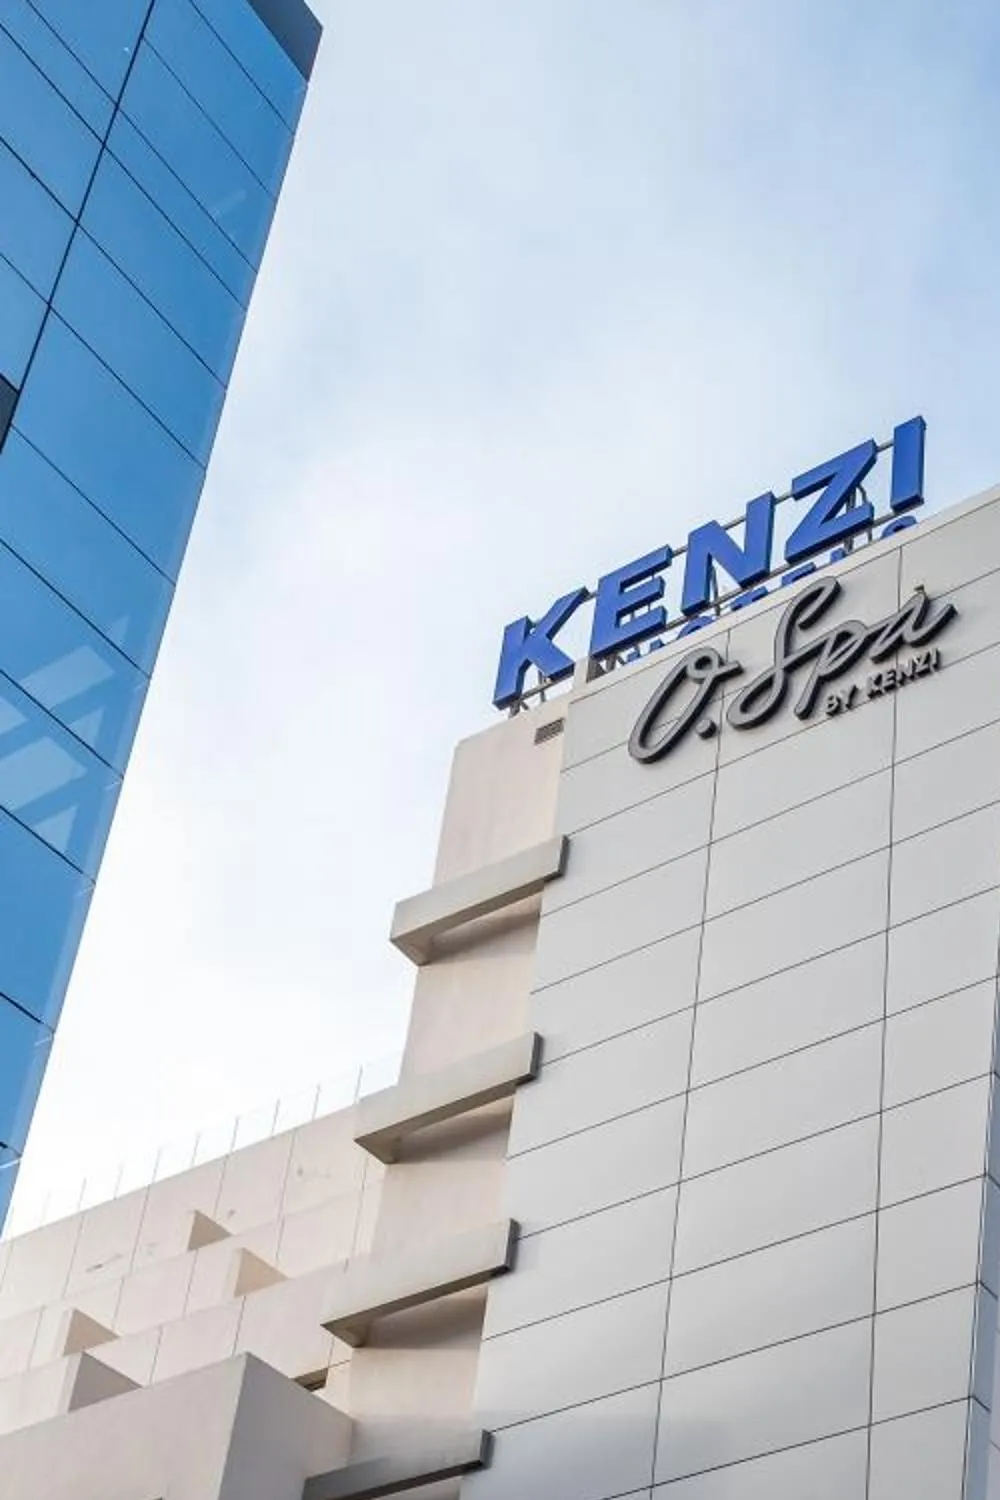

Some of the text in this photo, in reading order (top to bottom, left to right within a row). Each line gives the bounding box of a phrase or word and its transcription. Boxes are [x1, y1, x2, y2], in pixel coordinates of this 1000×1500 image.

[493, 415, 927, 708] KENZI
[824, 648, 941, 716] BY KENZI
